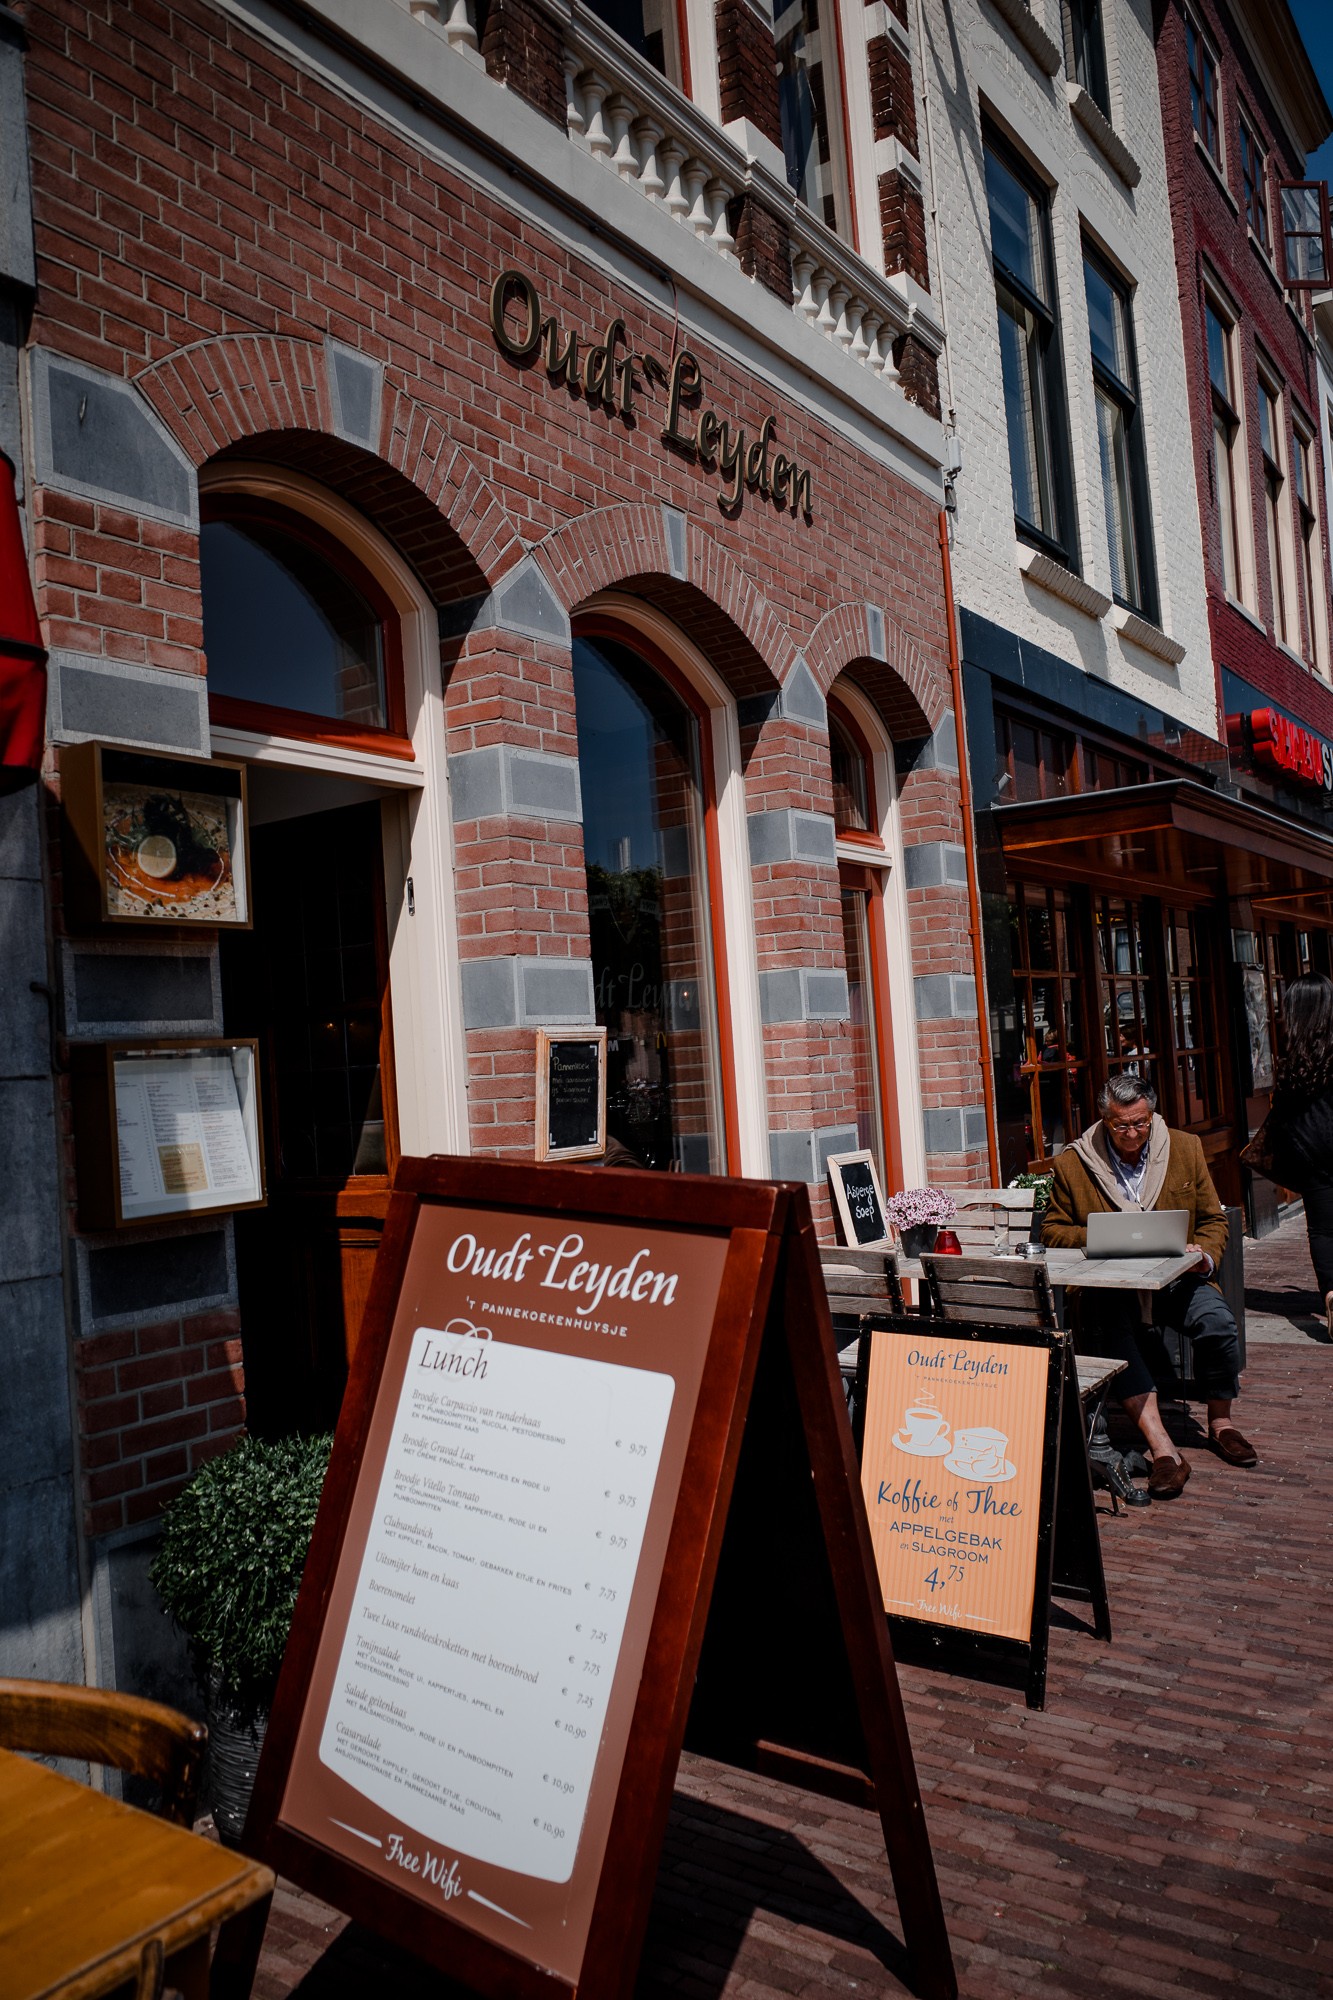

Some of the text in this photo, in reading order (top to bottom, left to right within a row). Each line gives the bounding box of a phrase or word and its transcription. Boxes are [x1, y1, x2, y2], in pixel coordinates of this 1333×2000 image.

[490, 270, 815, 514] Oudt Leyden
[846, 1183, 874, 1205] Asperge
[855, 1205, 875, 1223] Soep
[446, 1232, 679, 1316] Oudt Leyden
[466, 1295, 628, 1338] 'T PANNEKOEKENHUYSJE
[417, 1339, 489, 1381] Lunch
[907, 1350, 1009, 1379] Oudt Leyden
[411, 1388, 542, 1429] Broodje Carpaccio van runderhaas
[411, 1411, 480, 1434] EN PARMEZAANSE KAAS
[413, 1402, 425, 1410] MET
[511, 1425, 566, 1445] PESTODRESSING
[401, 1432, 476, 1462] Broodje Gravad Lax
[614, 1439, 623, 1448] €
[403, 1447, 416, 1456] MET
[468, 1465, 509, 1482] KAPPERTJES
[510, 1476, 521, 1484] EN
[521, 1478, 541, 1491] RODE
[542, 1484, 551, 1493] UI
[393, 1468, 480, 1504] Broodje Vitello Tonnato
[604, 1489, 611, 1499] €
[877, 1479, 1023, 1518] Koffie of Thee
[395, 1483, 407, 1492] MET
[507, 1516, 527, 1528] RODE
[528, 1522, 537, 1531] UI
[537, 1525, 548, 1534] EN
[939, 1514, 954, 1524] met
[383, 1514, 434, 1540] Clubsandwich
[595, 1530, 603, 1539] €
[890, 1521, 1002, 1551] APPELGEBAK
[384, 1528, 397, 1538] MET
[479, 1559, 514, 1577] GEBAKKEN
[515, 1571, 535, 1584] EITJE
[536, 1577, 546, 1587] EN
[547, 1581, 573, 1596] FRITES
[900, 1542, 989, 1563] en SLAGROOM
[375, 1550, 460, 1590] Uitsmijter ham en kaas
[368, 1578, 416, 1606] Boerenomelet
[584, 1581, 591, 1591] €
[916, 1599, 962, 1619] Free Wifi
[575, 1623, 583, 1633] €
[356, 1634, 401, 1663] Tonijnsalade
[362, 1606, 540, 1685] Twee Luxe rundvleeskroketten met boerenbrood
[568, 1654, 576, 1665] €
[354, 1659, 410, 1689] MOSTERDDRESSING
[356, 1650, 369, 1659] MET
[397, 1667, 415, 1680] RODE
[471, 1697, 492, 1712] APPEL
[494, 1707, 505, 1717] EN
[344, 1682, 408, 1719] Salade geitenkaas
[561, 1686, 569, 1697] €
[335, 1721, 382, 1752] Ceasarsalade
[345, 1697, 358, 1708] MET
[418, 1730, 437, 1745] RODE
[438, 1739, 446, 1748] UI
[446, 1743, 457, 1753] EN
[554, 1718, 587, 1739] € 10,90
[336, 1736, 349, 1746] MET
[350, 1743, 381, 1763] GEROOKTE
[411, 1772, 441, 1791] GEKOOKT
[393, 1774, 403, 1785] EN
[403, 1779, 448, 1807] PARMEZAANSE
[449, 1801, 466, 1816] KAAS
[542, 1773, 575, 1795] € 10,90
[532, 1817, 566, 1839] € 10,90
[385, 1833, 463, 1899] Free Wifi
